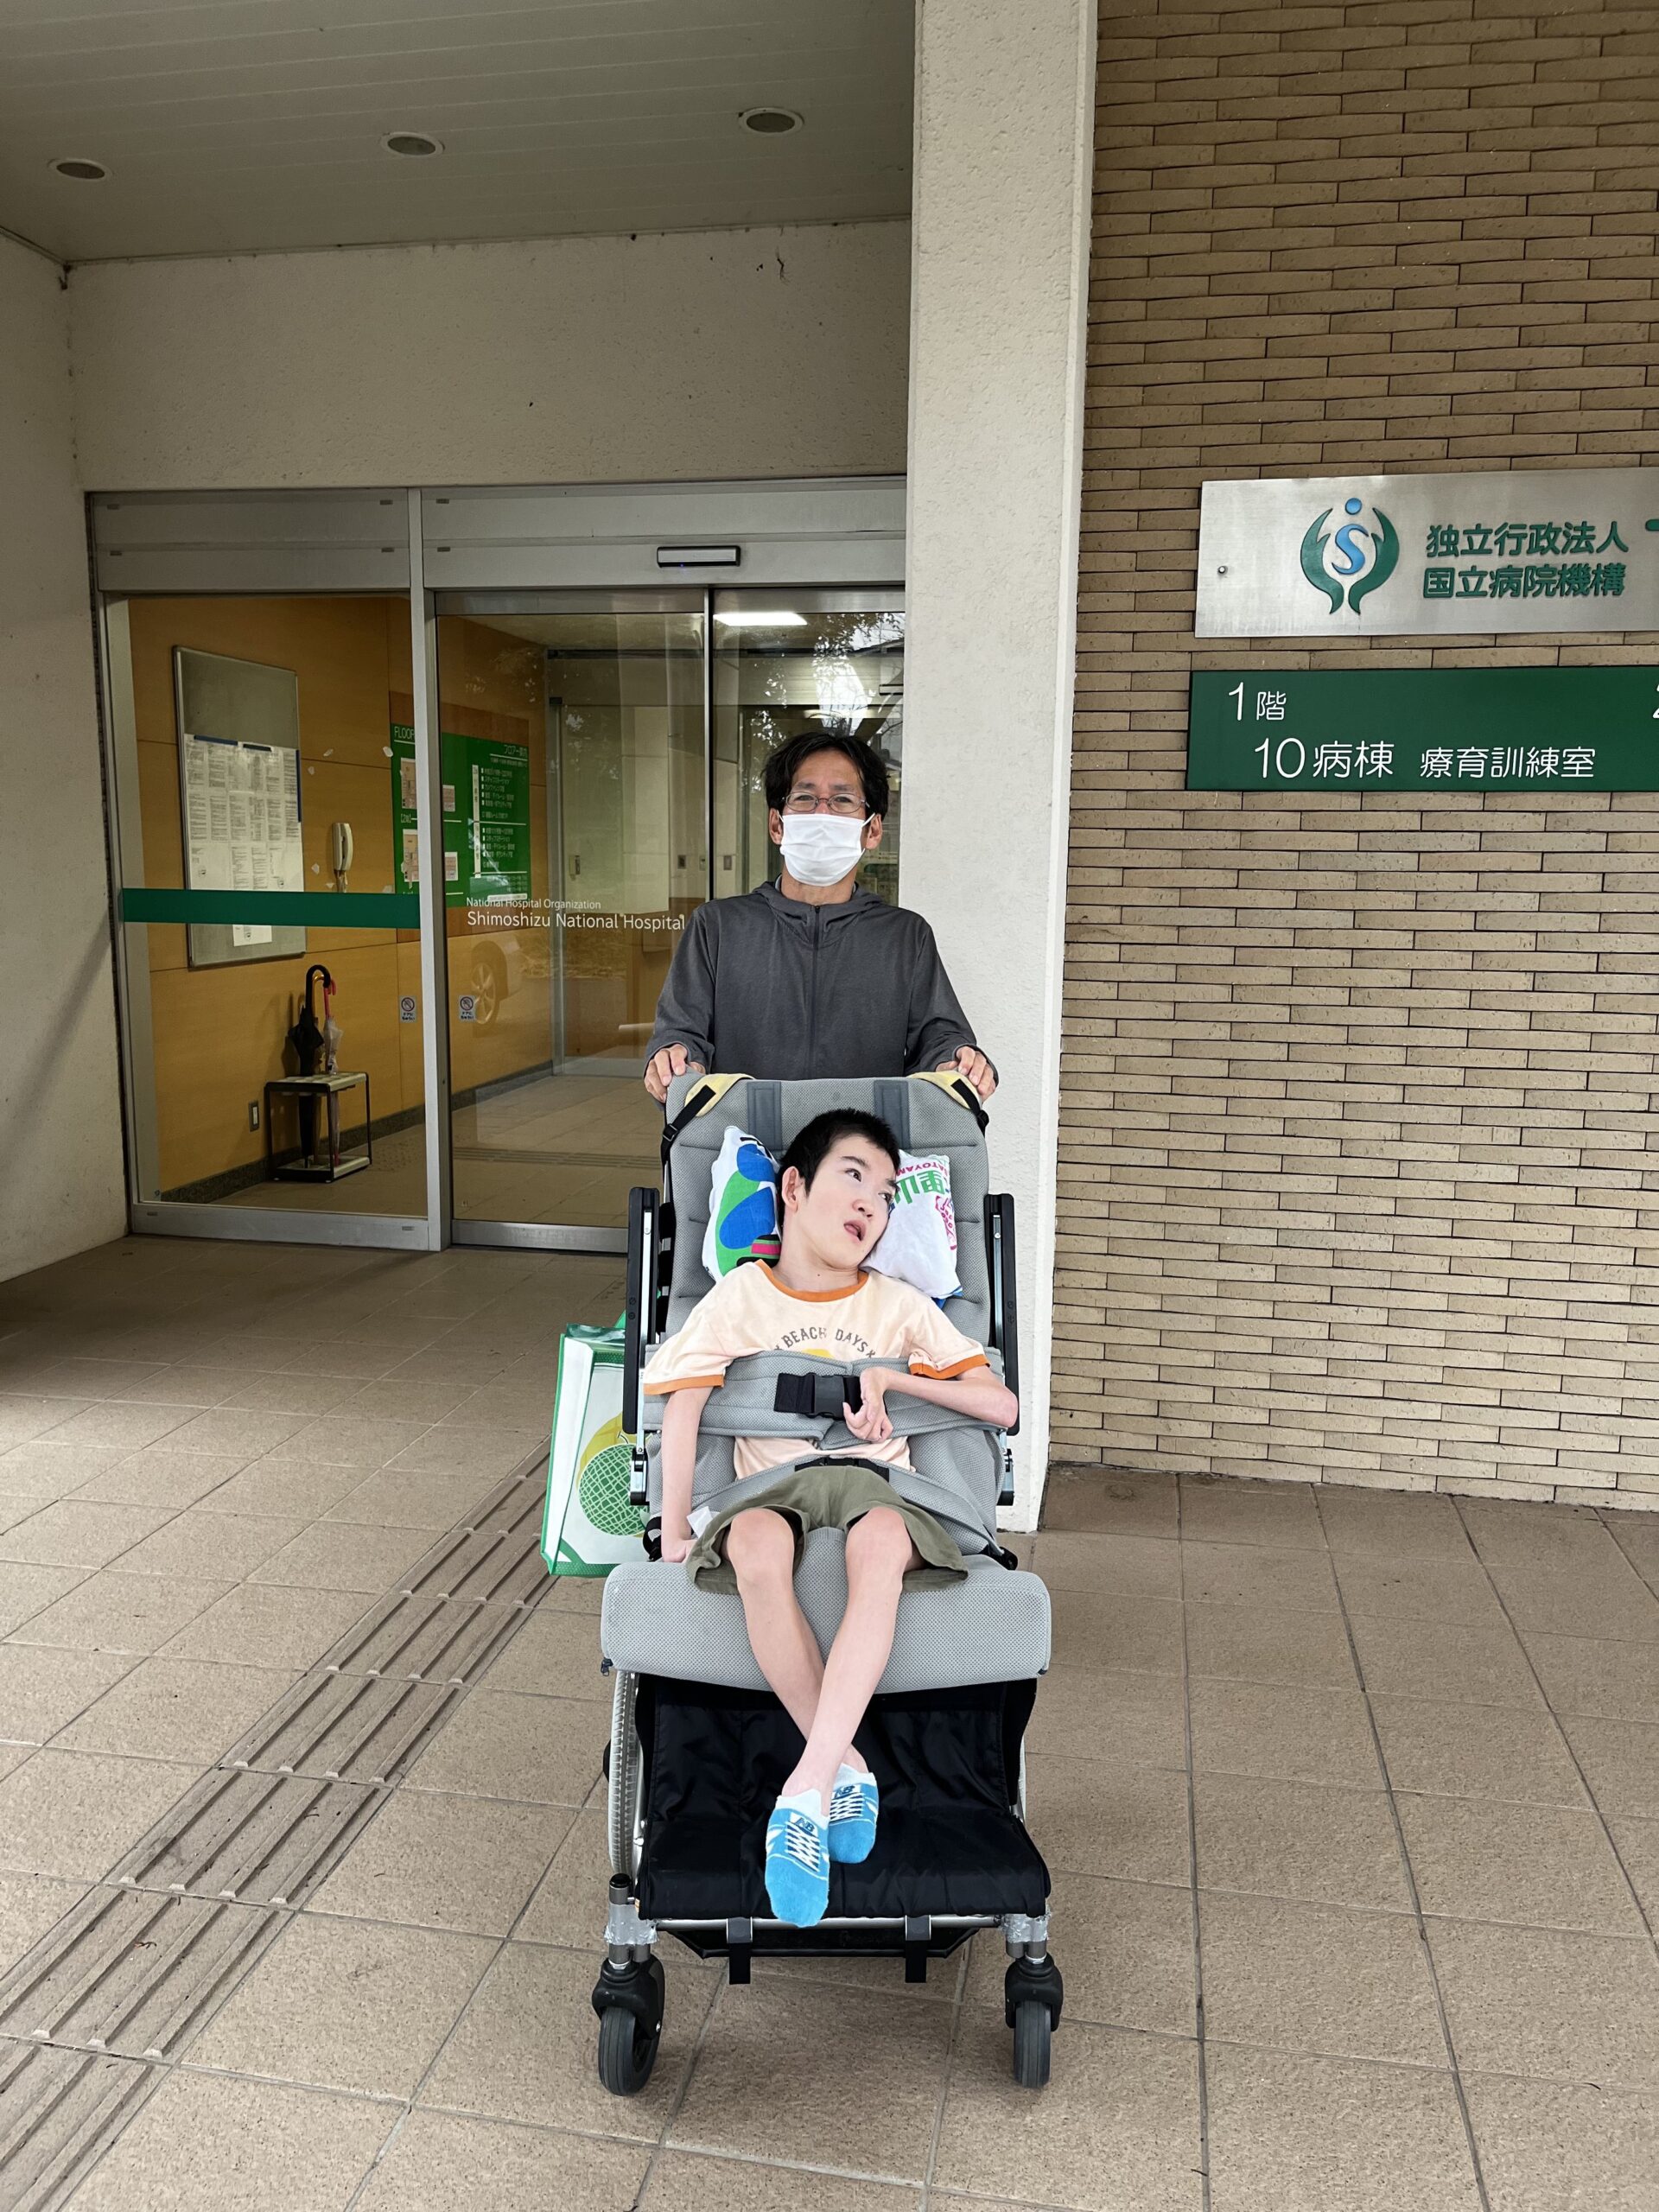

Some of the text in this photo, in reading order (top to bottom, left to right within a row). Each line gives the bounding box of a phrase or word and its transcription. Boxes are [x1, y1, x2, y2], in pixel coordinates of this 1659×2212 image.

[1426, 520, 1630, 558] 独立行政法人
[1423, 563, 1627, 599] 国立病院機構
[1228, 681, 1287, 721] 1階
[1254, 737, 1596, 779] 10病棟 療育訓練室
[467, 897, 504, 908] National
[505, 898, 542, 911] Hospital
[543, 899, 601, 912] Organization
[467, 911, 685, 933] Shimoshizu National Hospital
[781, 1326, 868, 1352] BEACH DAYS
